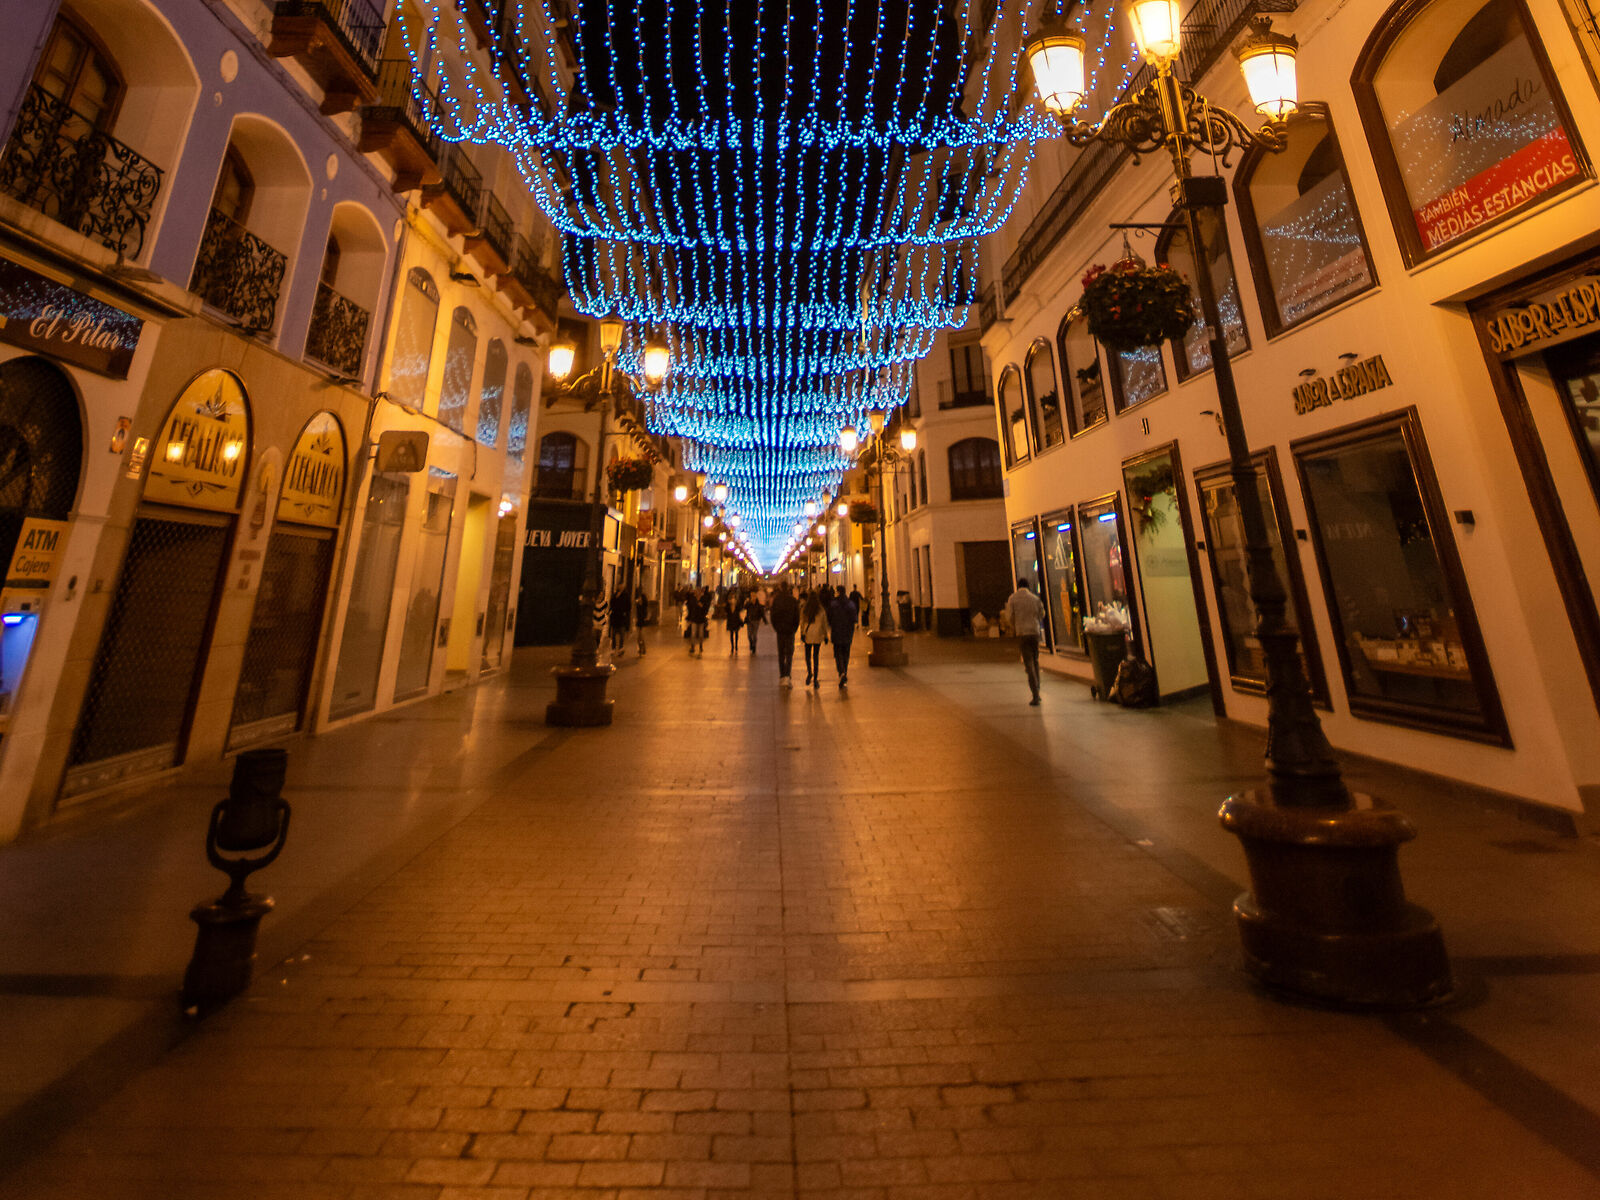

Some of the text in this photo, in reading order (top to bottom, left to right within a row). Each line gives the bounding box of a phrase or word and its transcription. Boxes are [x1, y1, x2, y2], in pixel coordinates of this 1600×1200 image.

[1453, 77, 1541, 143] Almada
[1426, 154, 1576, 246] MEDIAS ESTANCIAS
[30, 304, 120, 351] El Pilar
[1487, 304, 1551, 353] SABOR
[1292, 377, 1332, 416] SABOR
[24, 529, 59, 551] ATM
[15, 555, 50, 577] Cajero
